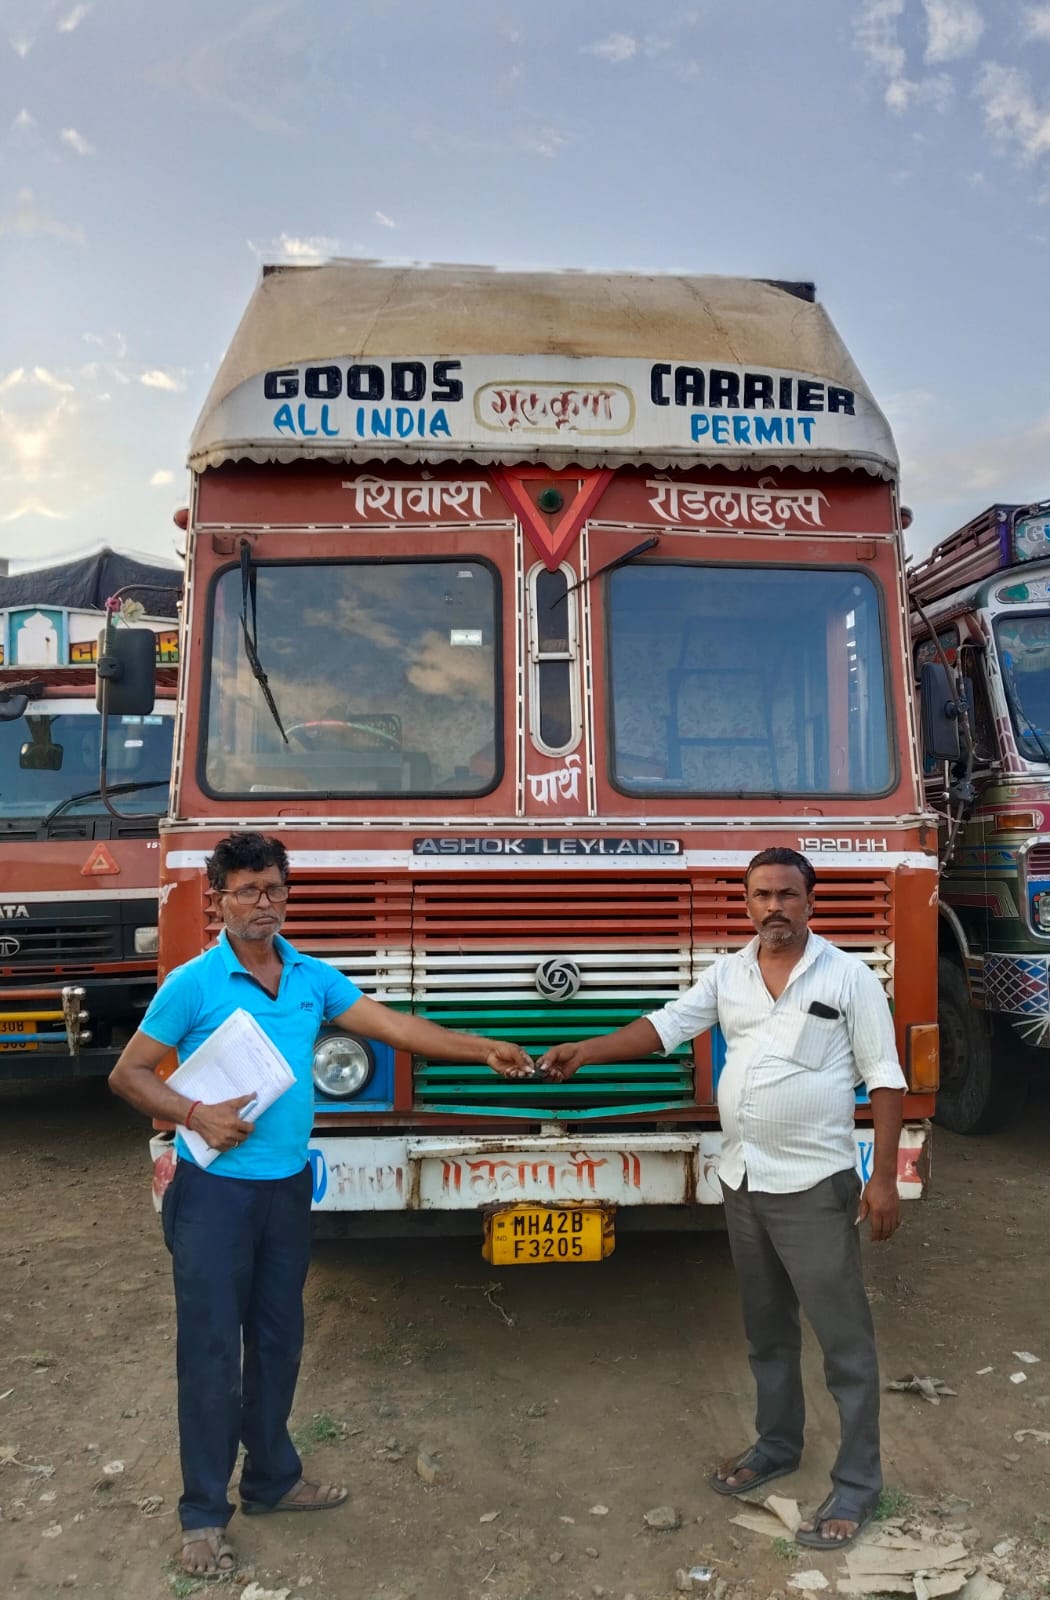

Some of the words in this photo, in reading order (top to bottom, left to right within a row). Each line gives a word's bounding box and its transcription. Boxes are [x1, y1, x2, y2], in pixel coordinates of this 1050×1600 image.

[264, 360, 464, 402] GOODS
[651, 363, 856, 416] CARRIER
[273, 403, 341, 436] ALL
[356, 407, 452, 438] INDIA
[690, 414, 816, 445] PERMIT
[527, 754, 583, 806] पार्थ
[418, 838, 523, 854] ASHOK
[543, 838, 680, 854] LEYLAND
[514, 1212, 583, 1236] MH42B
[514, 1237, 583, 1258] F3205
